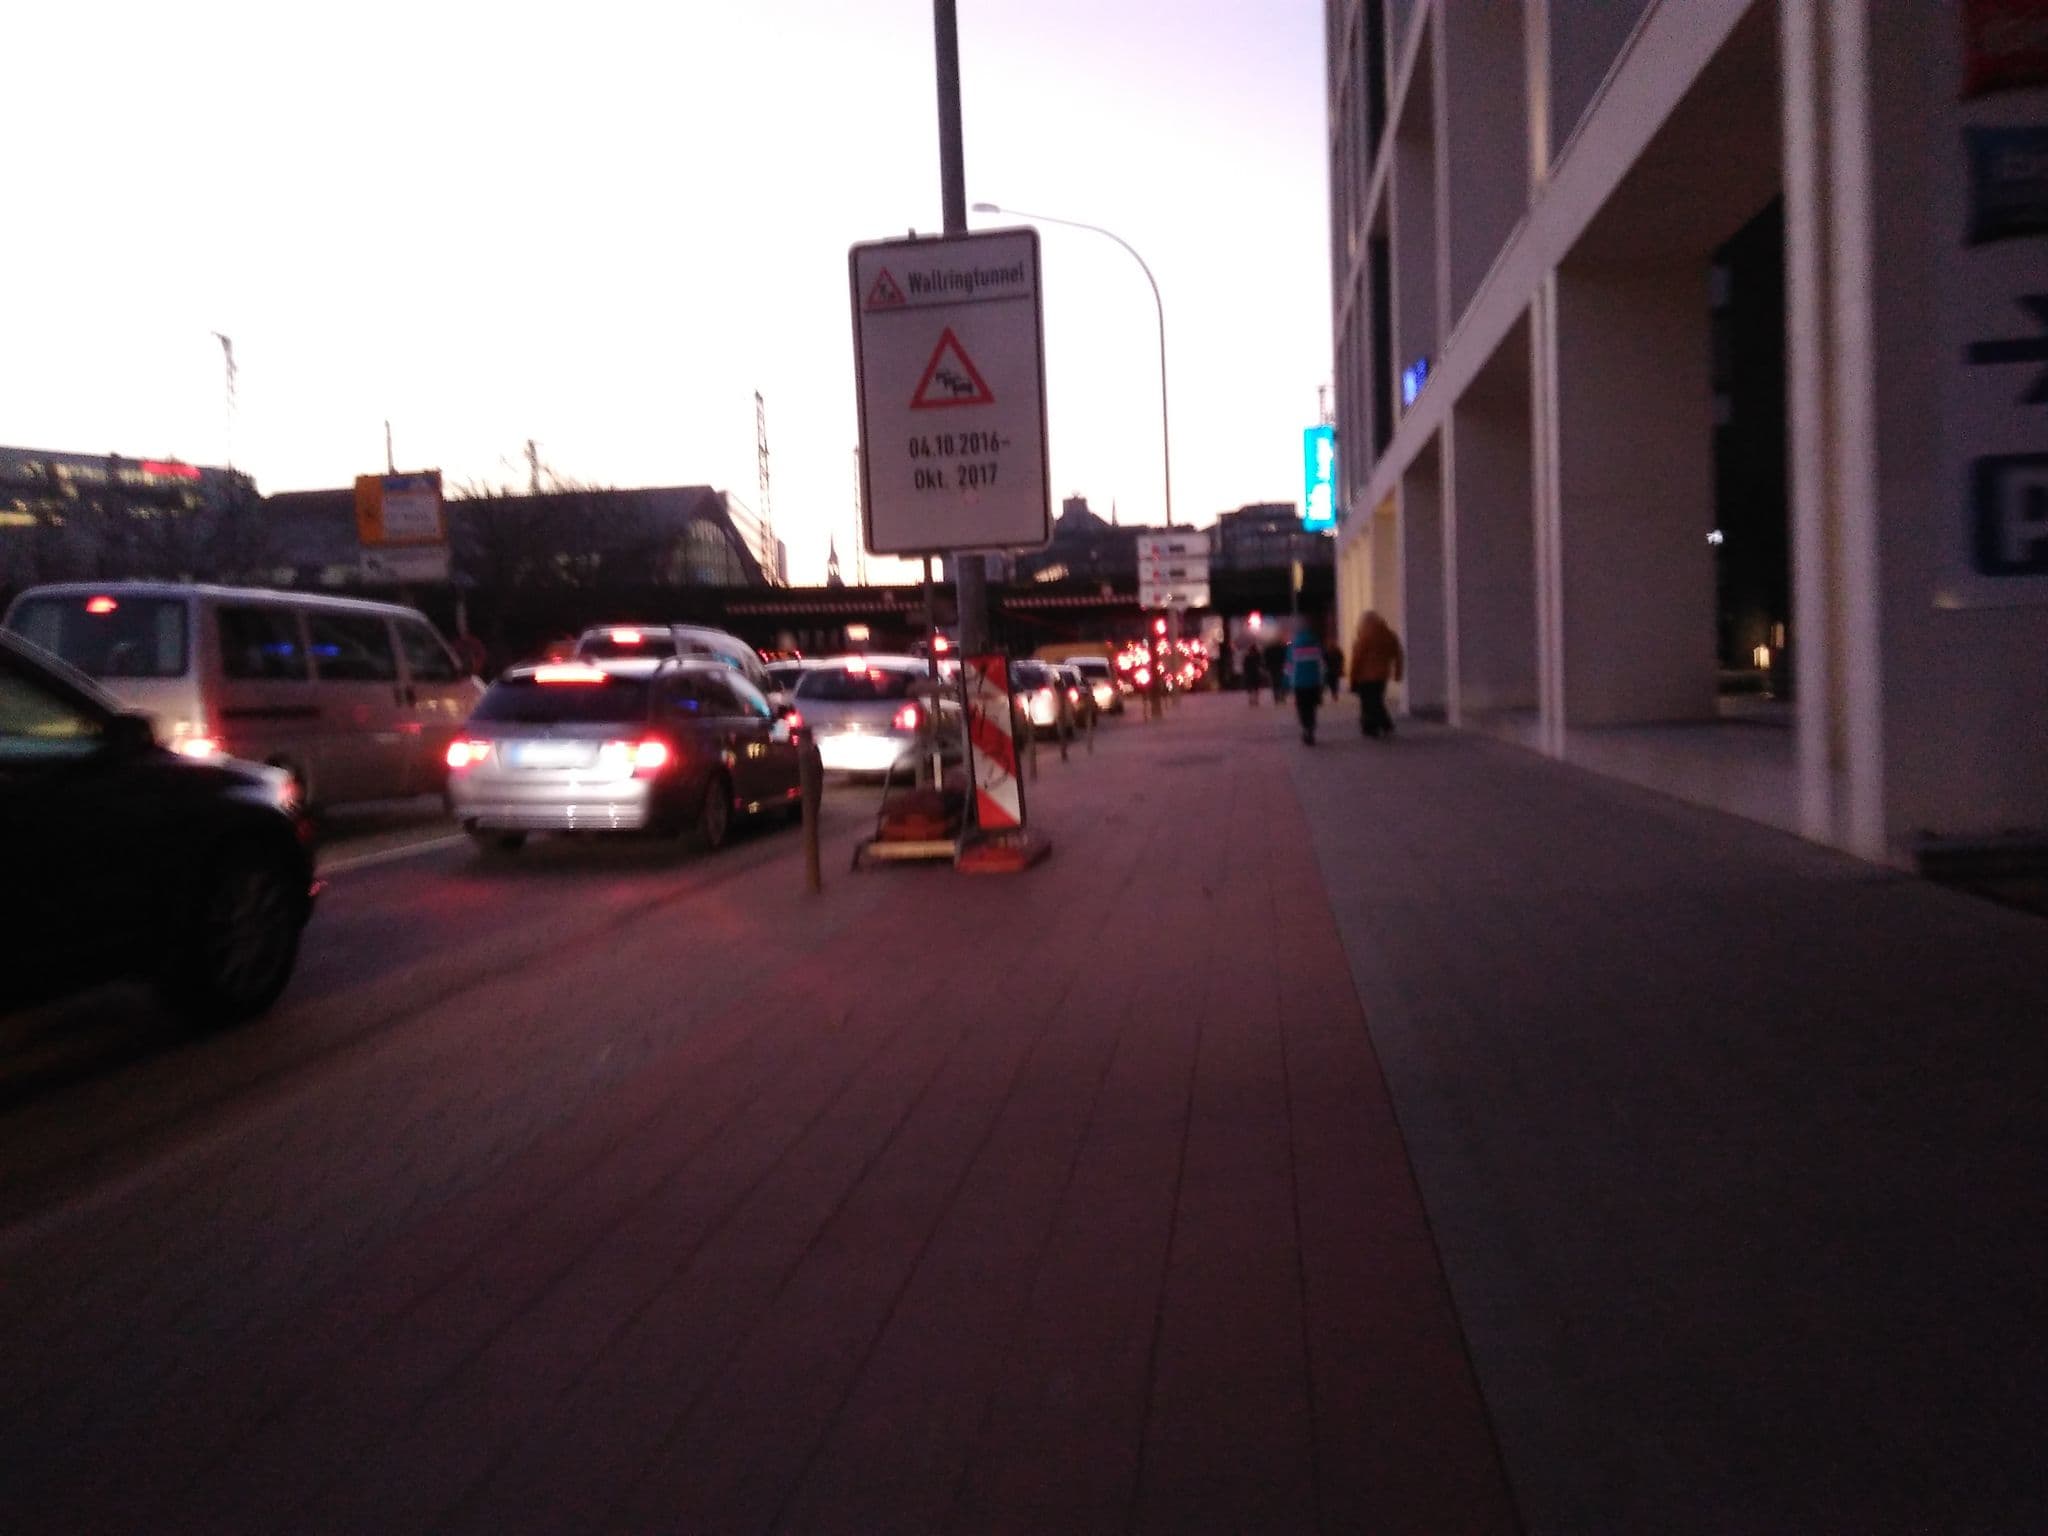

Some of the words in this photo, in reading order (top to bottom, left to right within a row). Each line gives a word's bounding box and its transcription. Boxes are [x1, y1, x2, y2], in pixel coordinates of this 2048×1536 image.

[908, 262, 1024, 293] Wallringtunnel
[914, 469, 949, 490] Okt.
[957, 463, 998, 488] 2017
